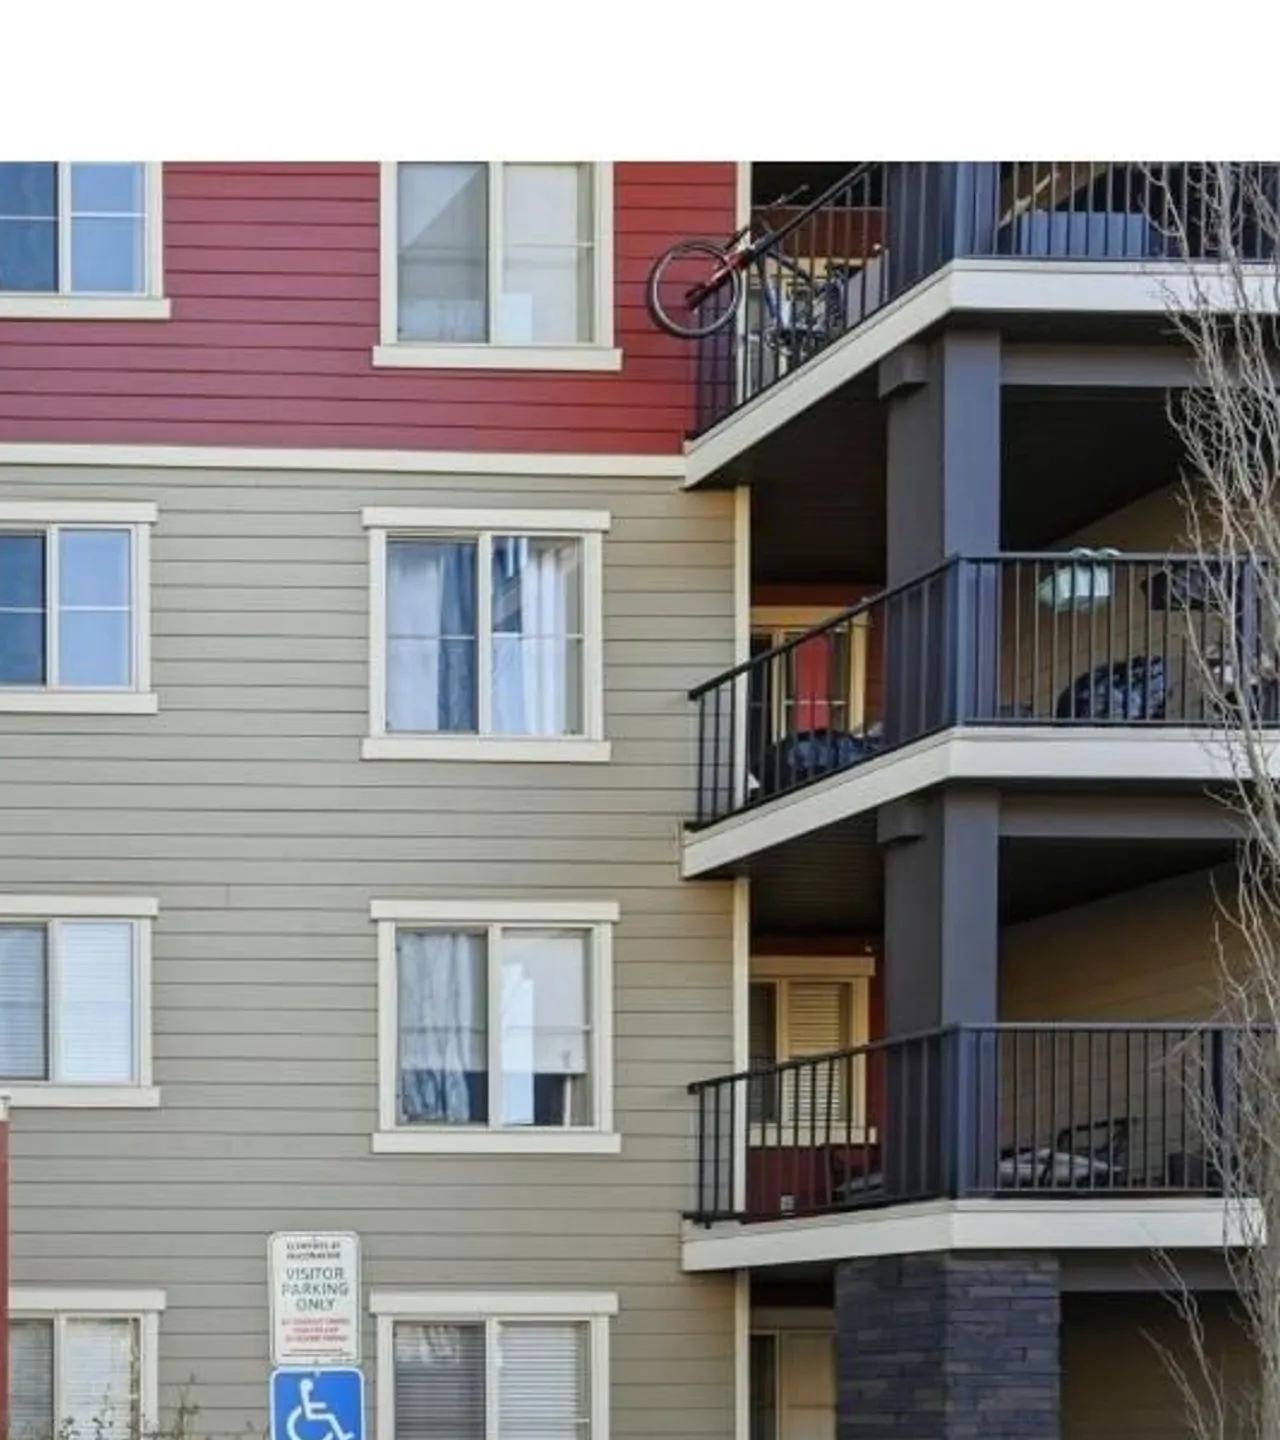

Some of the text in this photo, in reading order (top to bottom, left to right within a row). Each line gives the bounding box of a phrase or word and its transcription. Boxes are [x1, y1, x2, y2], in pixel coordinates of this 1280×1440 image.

[286, 1267, 344, 1280] VISITOR
[281, 1282, 349, 1296] PARKING
[296, 1298, 335, 1311] ONLY
